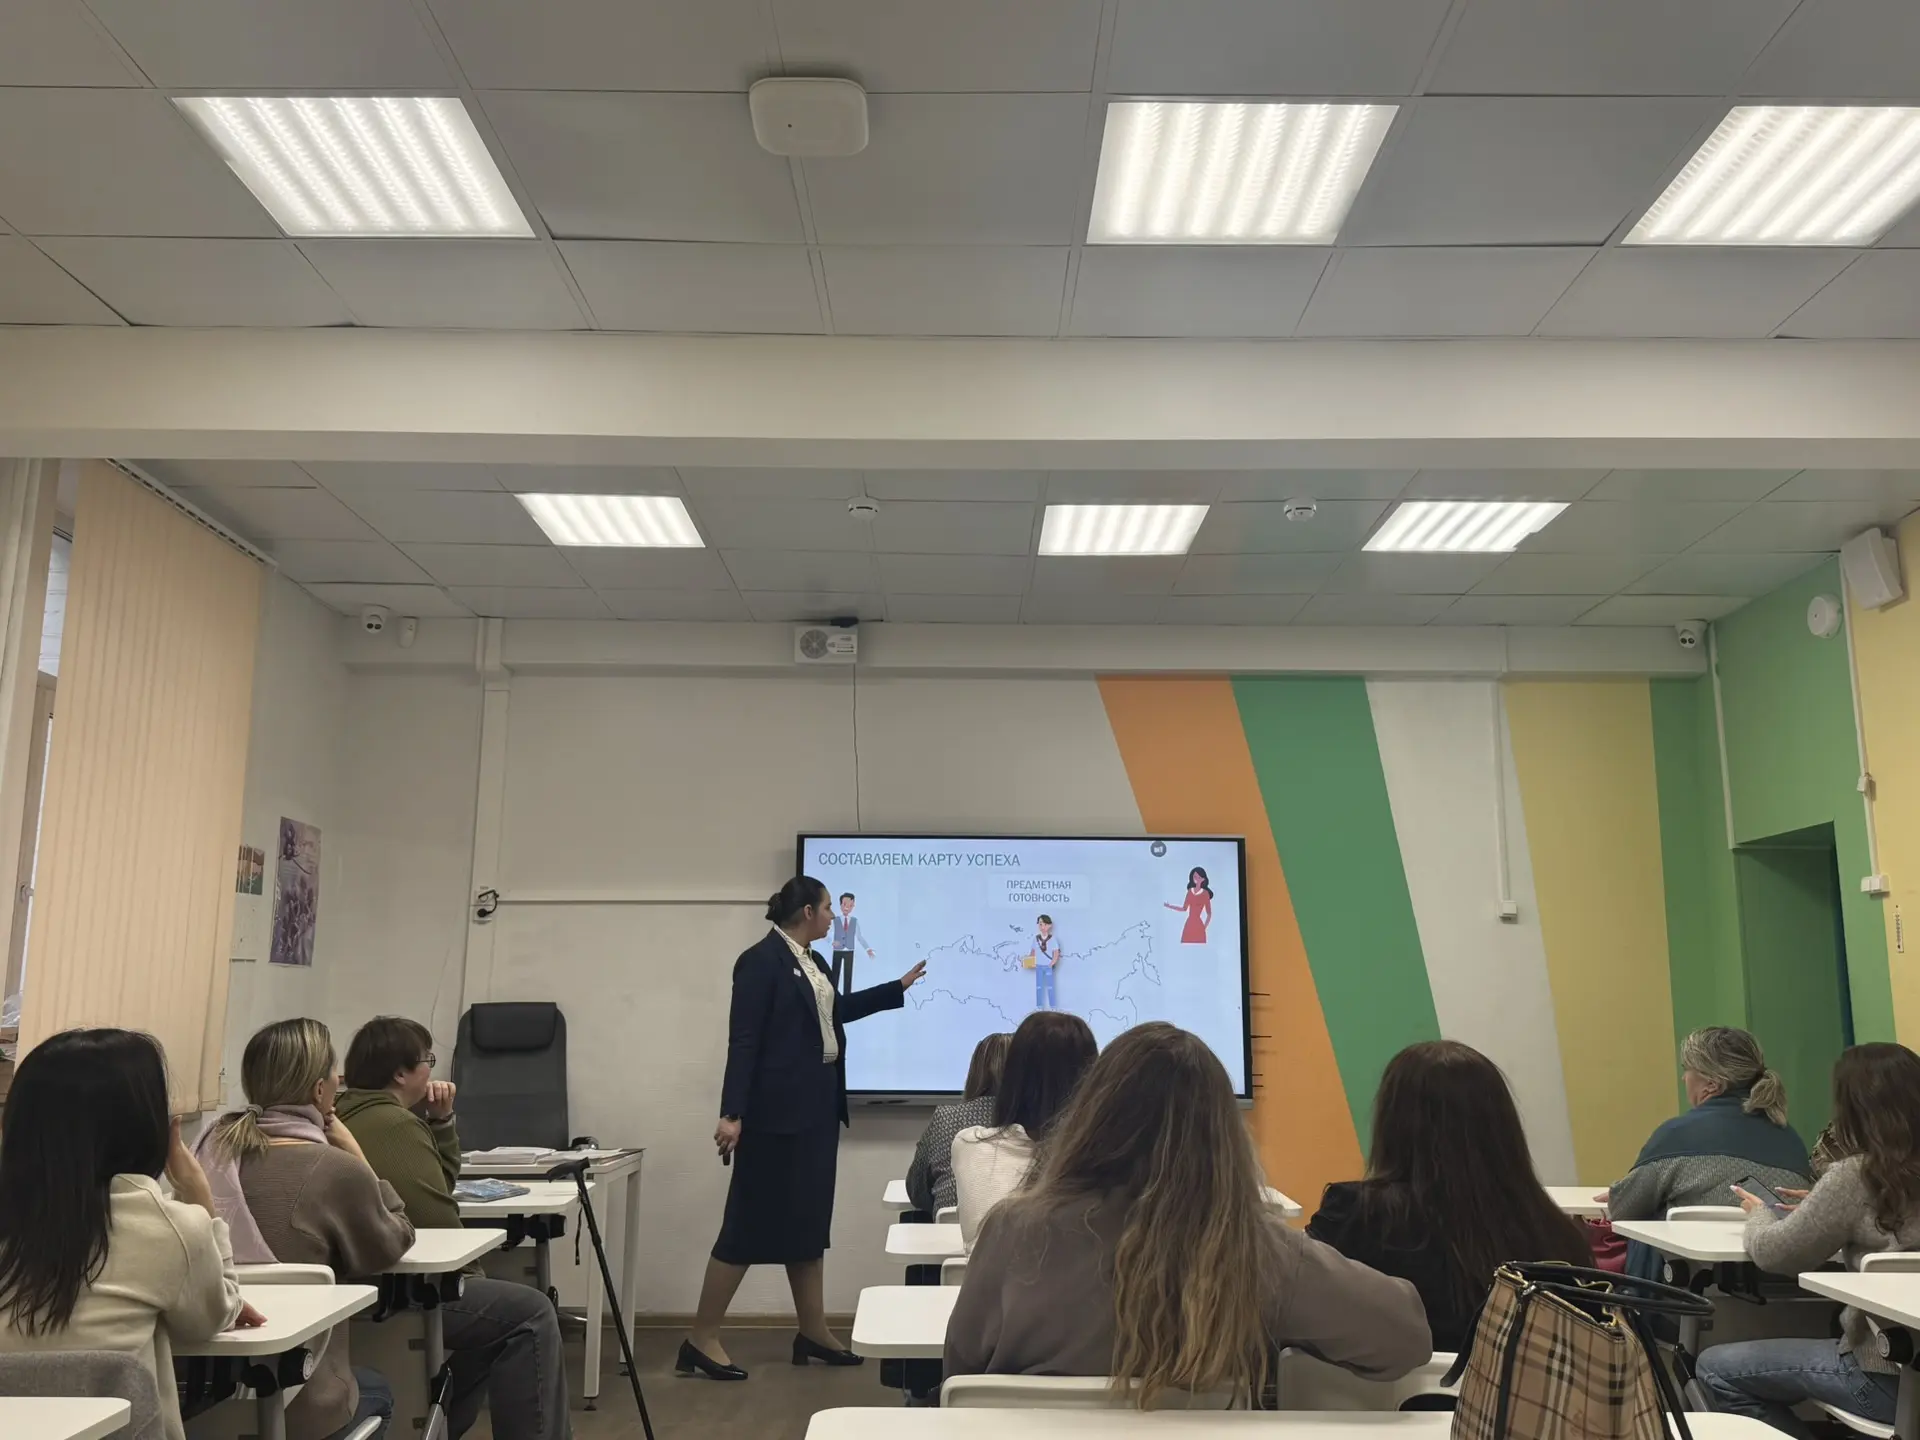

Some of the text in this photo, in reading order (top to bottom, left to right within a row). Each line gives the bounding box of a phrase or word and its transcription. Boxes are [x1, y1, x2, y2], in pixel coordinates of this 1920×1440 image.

[819, 852, 1020, 867] СОСТАВЛЯЕМ КАРТУ УСПЕХА
[1006, 880, 1071, 889] ПРЕДМЕТНАЯ
[1009, 893, 1070, 902] ГОТОВНОСТЬ
